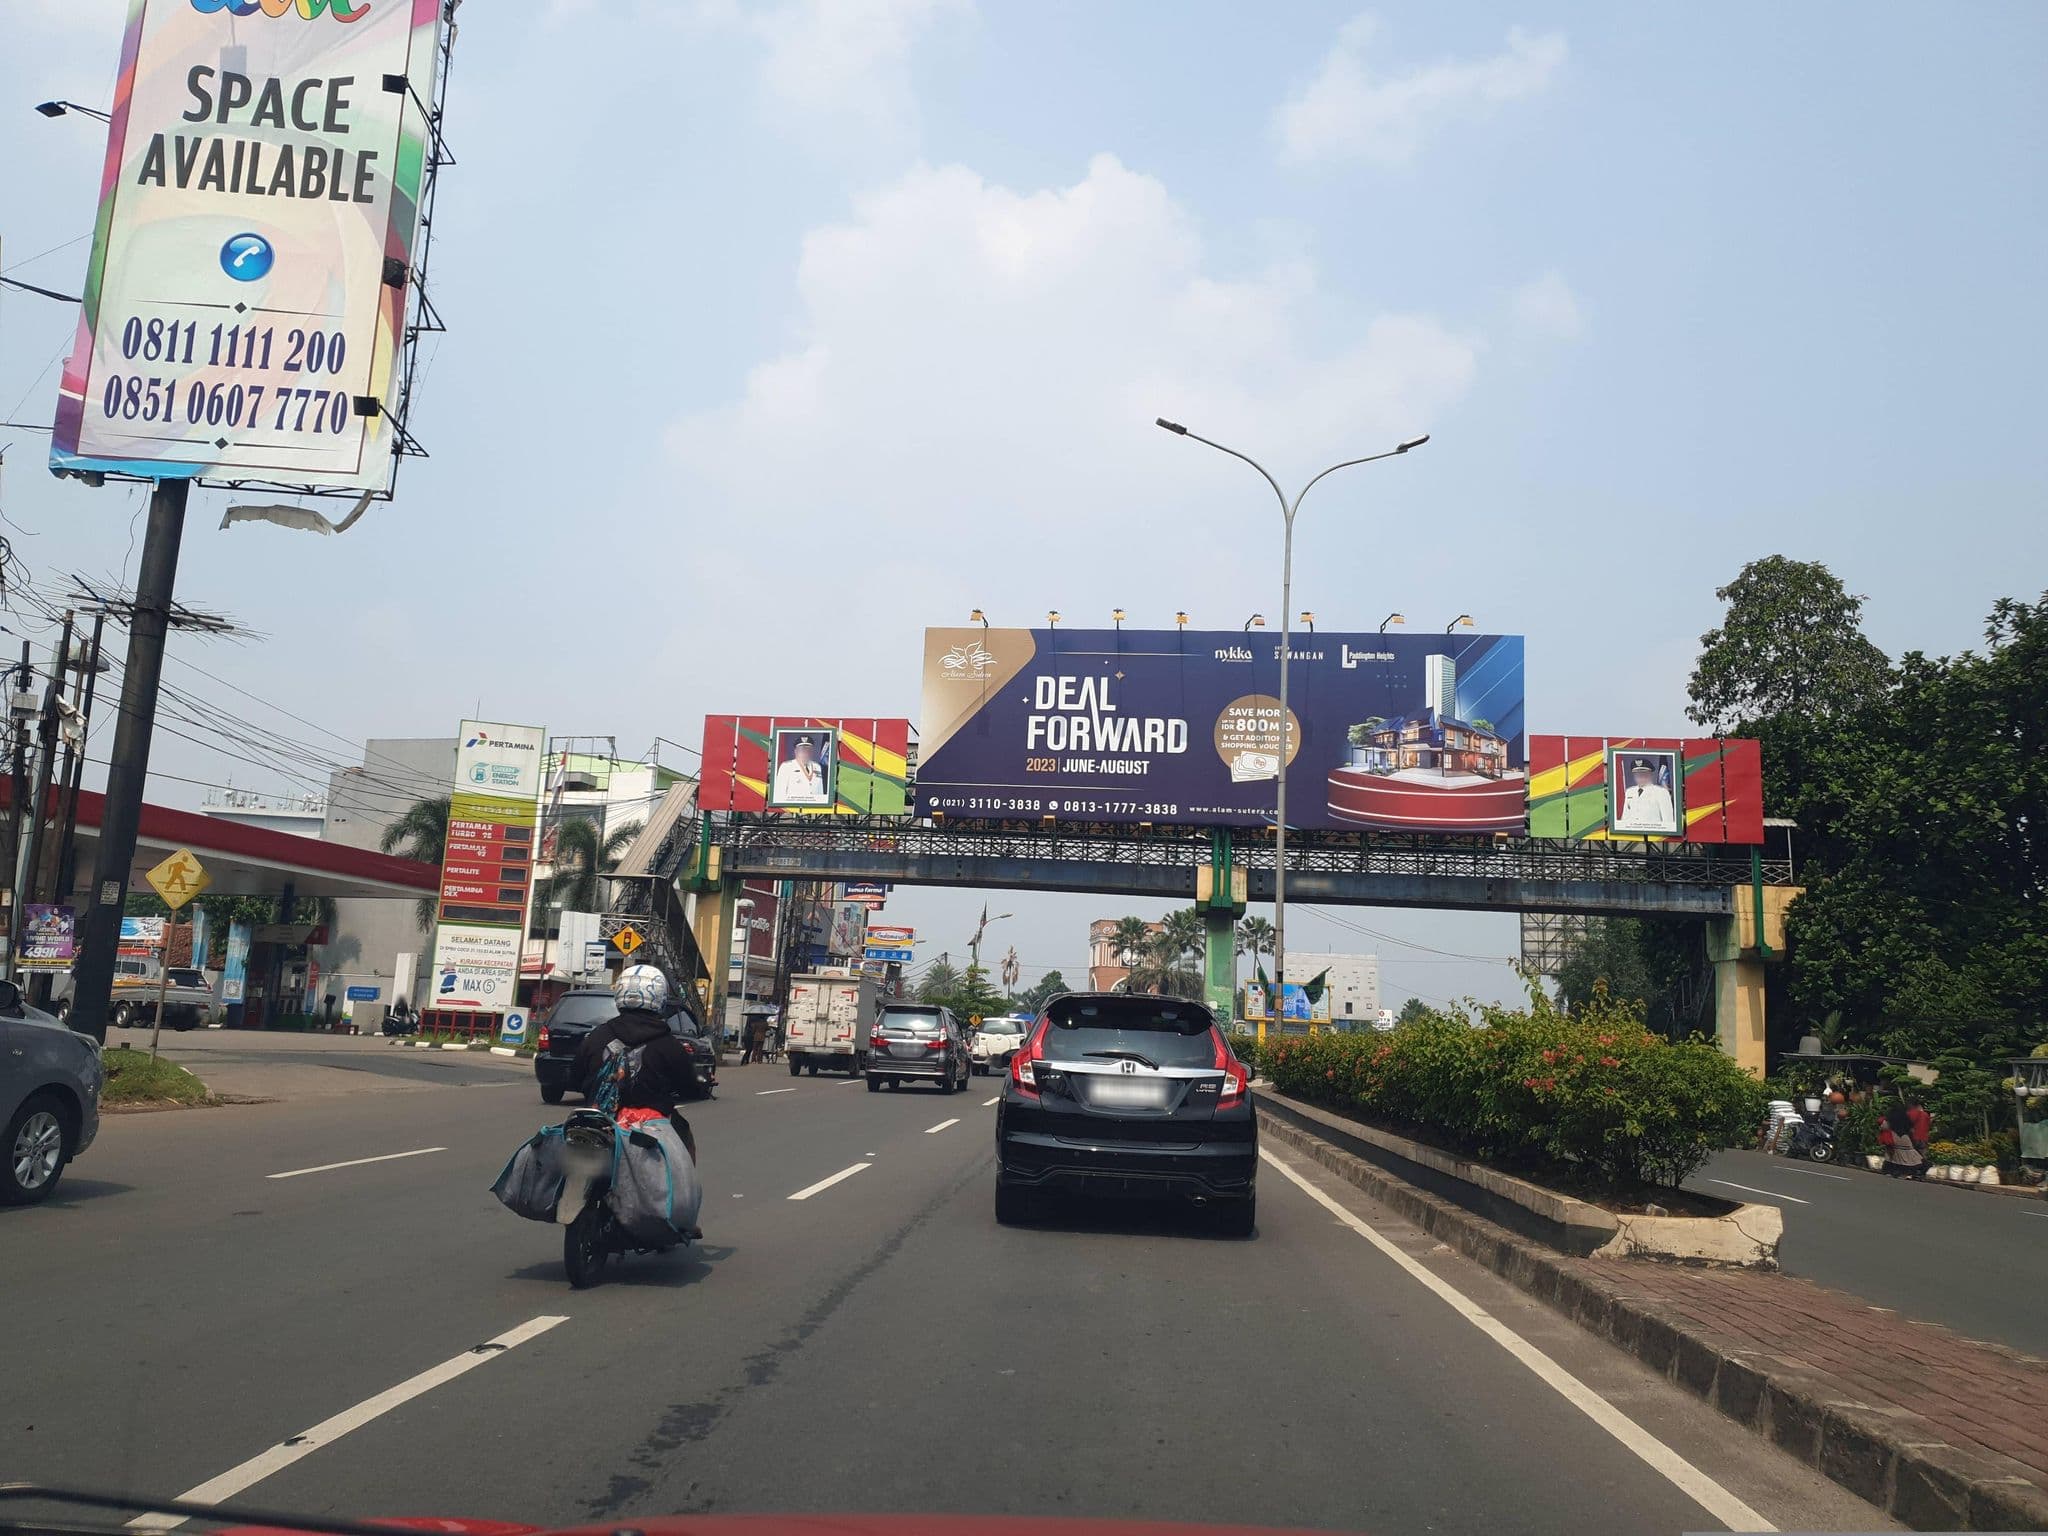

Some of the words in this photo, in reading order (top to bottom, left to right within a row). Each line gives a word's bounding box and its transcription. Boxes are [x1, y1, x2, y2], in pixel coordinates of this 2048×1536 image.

[182, 64, 355, 133] SPACE
[137, 133, 379, 203] AVAILABLE
[122, 317, 196, 364] 0811
[208, 323, 274, 369] 1111
[283, 328, 346, 375] 200
[103, 374, 178, 422] 0851
[186, 381, 264, 428] 0607
[274, 388, 348, 435] 7770
[1215, 646, 1253, 663] nykka
[1274, 651, 1324, 660] SWANGAN
[1035, 675, 1116, 711] DEAL
[1229, 707, 1254, 717] SAVE
[1256, 708, 1281, 717] MOR
[1236, 718, 1268, 732] 800
[1269, 722, 1293, 731] MO
[1027, 715, 1188, 754] FORWARD
[489, 740, 535, 751] PERTAMINA
[1221, 742, 1257, 750] SHOPPING
[1026, 757, 1056, 772] 2023
[1062, 758, 1150, 775] JUNE-AUGUST
[492, 772, 518, 780] ENERGY
[942, 798, 965, 808] (021)
[969, 797, 1041, 810] 3110-3838
[1063, 801, 1178, 816] 0813-1777-3838
[1189, 804, 1279, 815] www.alam-sutera.co
[451, 821, 493, 831] PERTAMAX
[449, 843, 487, 851] PERTAMAX
[446, 866, 480, 875] PERTALITE
[444, 884, 483, 894] PERTAMINA
[451, 936, 482, 944] SELAMAT
[463, 978, 481, 992] MAX
